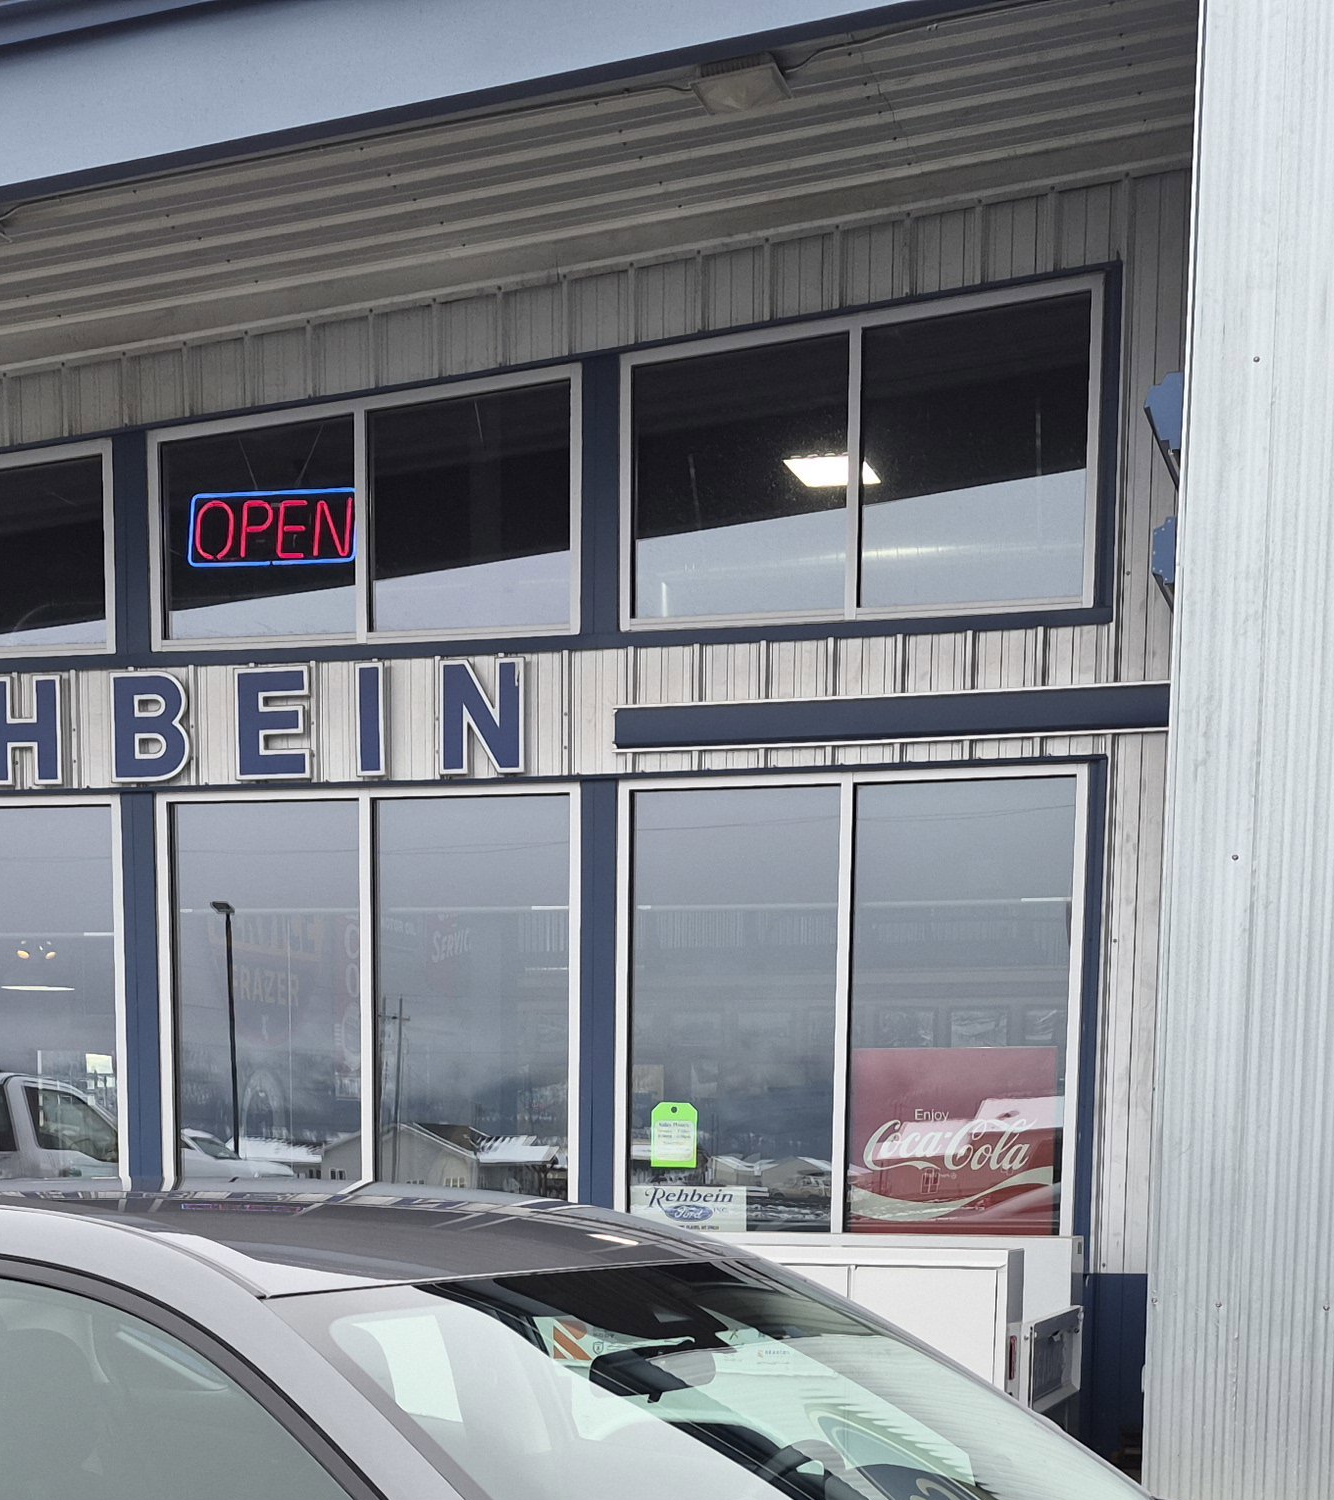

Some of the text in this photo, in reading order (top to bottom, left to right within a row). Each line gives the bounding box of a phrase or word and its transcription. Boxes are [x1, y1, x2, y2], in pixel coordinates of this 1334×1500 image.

[193, 498, 355, 561] OPEN
[431, 927, 472, 964] SERVIC
[914, 1108, 950, 1122] Enjoy
[863, 1119, 1038, 1171] Coca-Cola
[645, 1187, 734, 1211] Rehbein
[674, 1205, 703, 1219] Ford
